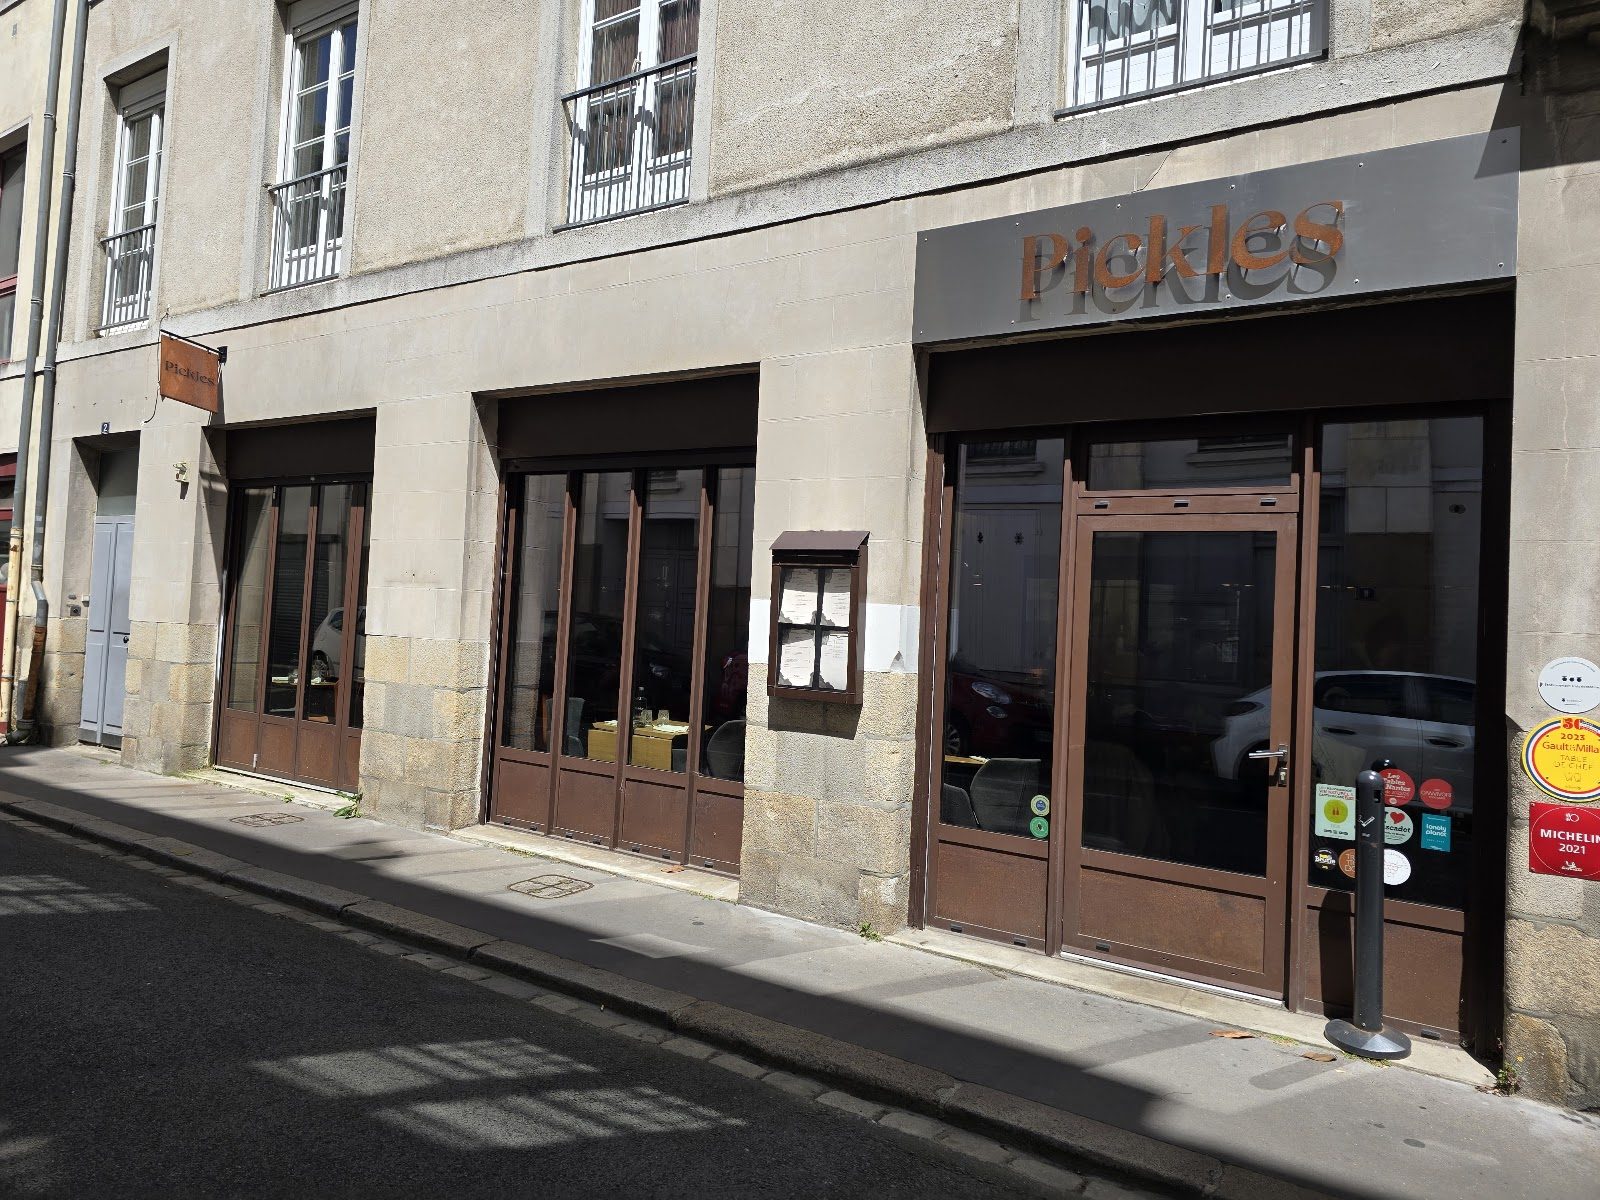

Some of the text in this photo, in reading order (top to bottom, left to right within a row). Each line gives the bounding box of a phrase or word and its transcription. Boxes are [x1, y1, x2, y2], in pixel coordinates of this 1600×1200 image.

[1019, 200, 1344, 301] Pickles
[165, 361, 215, 386] Pickles
[1560, 733, 1585, 741] 2023
[1542, 741, 1600, 754] Gault&Milla
[1560, 755, 1588, 763] TABLE
[1568, 762, 1593, 771] CHEF
[1385, 825, 1411, 834] scadet
[1426, 824, 1447, 832] lonely
[1425, 829, 1447, 837] planet
[1558, 843, 1586, 855] 2021
